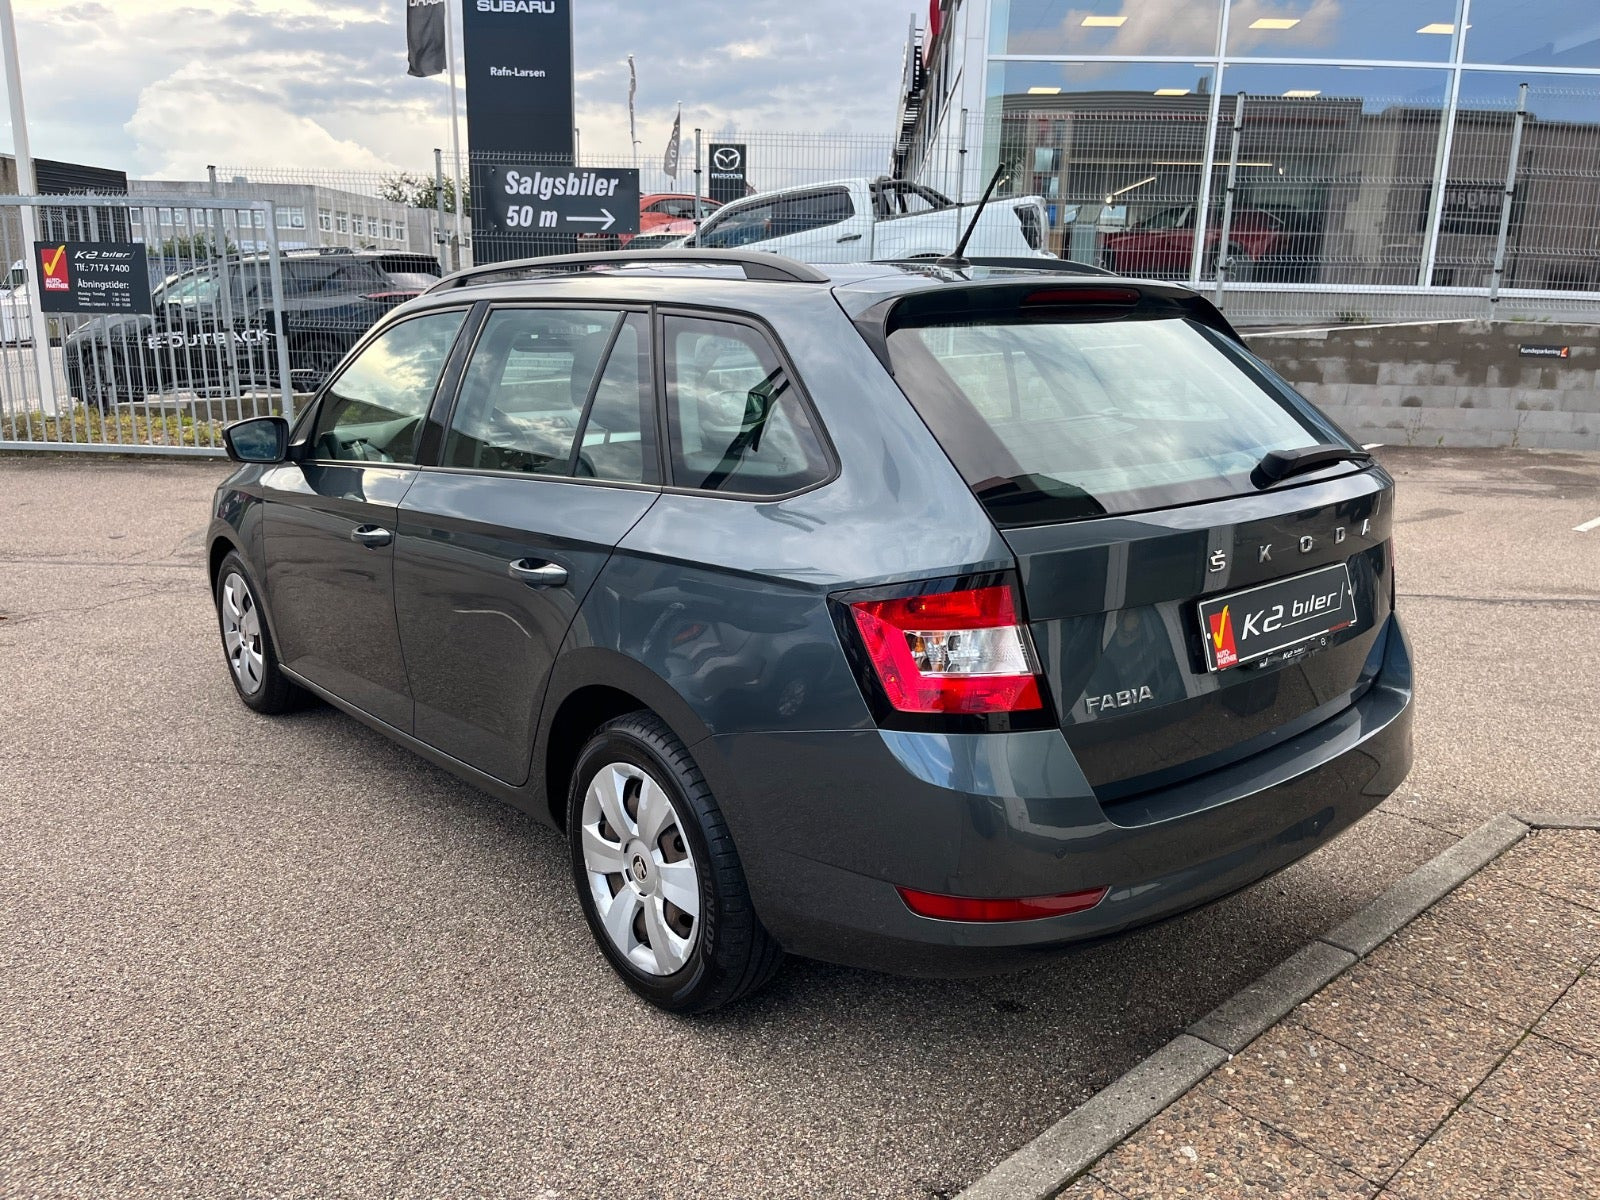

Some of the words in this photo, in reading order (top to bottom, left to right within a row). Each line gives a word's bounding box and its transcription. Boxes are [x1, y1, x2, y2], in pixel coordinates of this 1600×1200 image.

[477, 0, 555, 14] SUBARU
[490, 67, 546, 78] Rafn-Larsen
[505, 170, 619, 200] Salgsbiler
[506, 205, 534, 227] 50
[539, 210, 558, 228] m
[74, 250, 98, 260] K2
[89, 263, 109, 272] 7174
[109, 264, 130, 273] 7400
[77, 278, 130, 290] Åbningstider:
[1241, 604, 1284, 640] K2
[1217, 653, 1237, 666] PARTNER
[1085, 685, 1153, 714] FABIA
